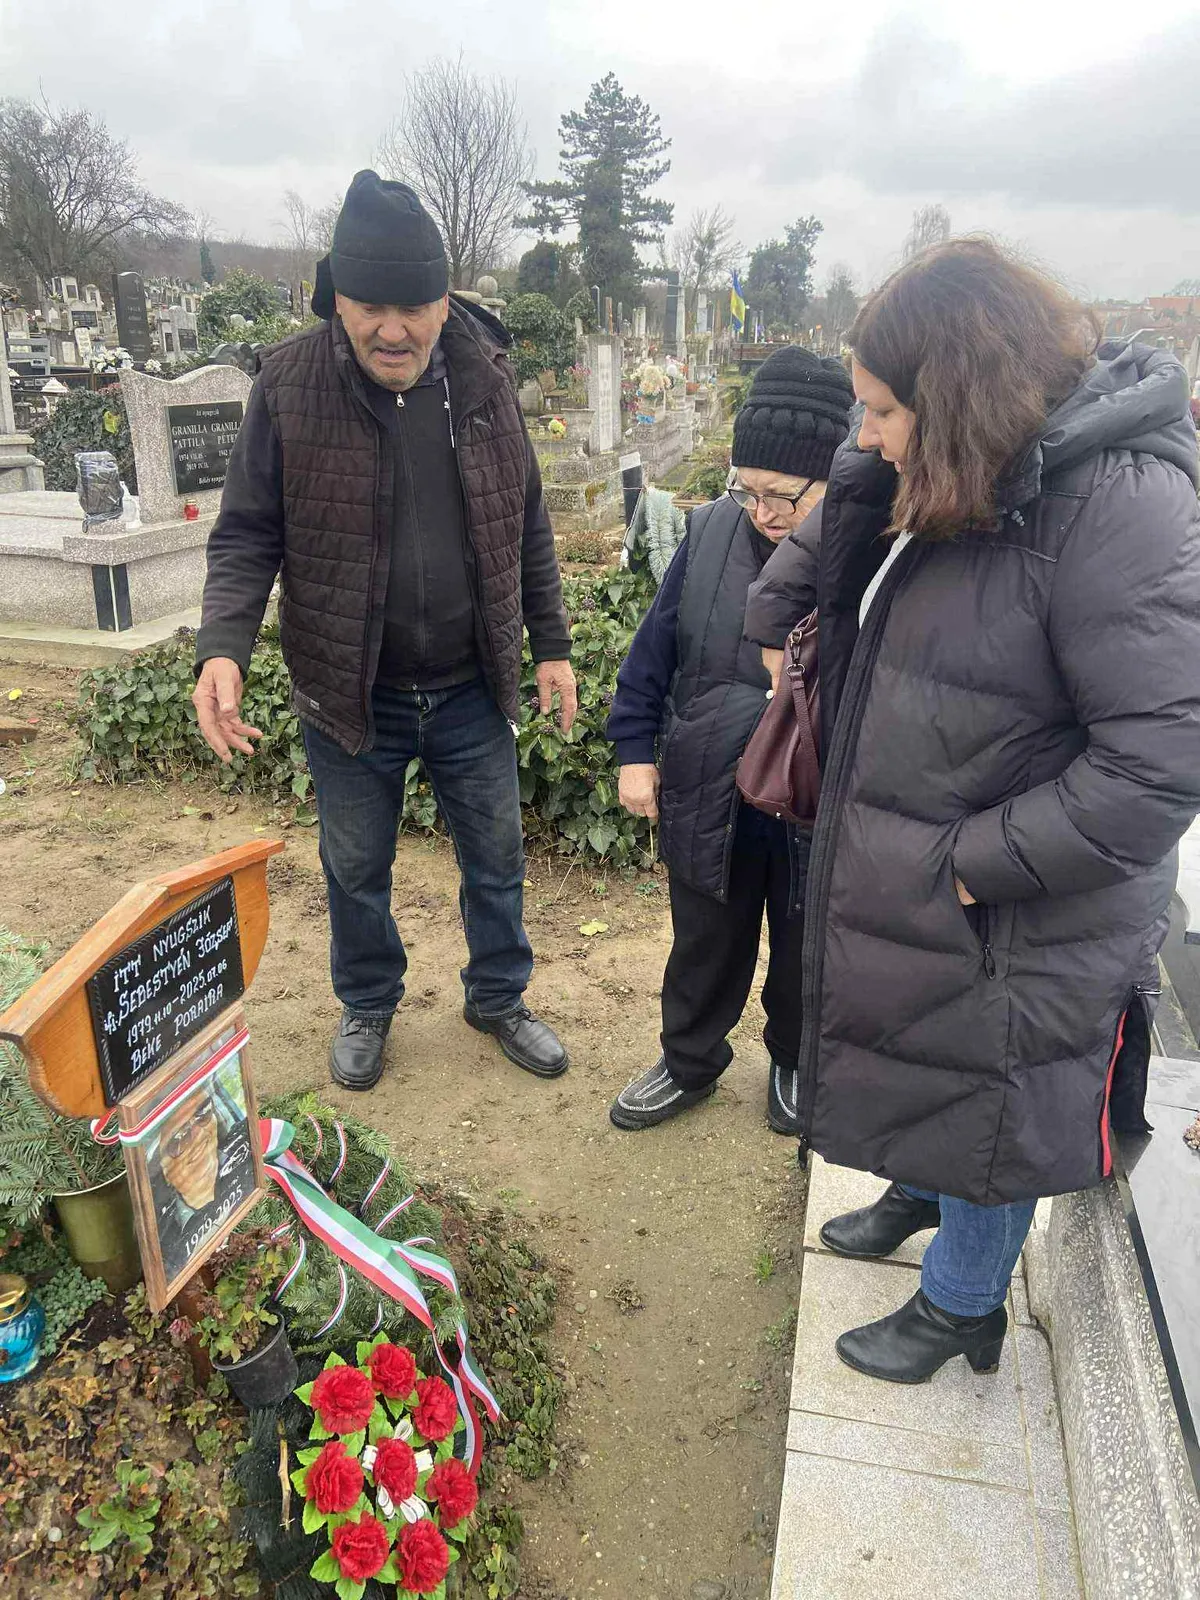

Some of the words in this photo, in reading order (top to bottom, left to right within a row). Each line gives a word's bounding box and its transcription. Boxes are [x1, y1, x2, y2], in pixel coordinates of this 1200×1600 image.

[172, 424, 208, 436] GRANILLA
[177, 437, 206, 449] ATTILA
[211, 421, 242, 433] GRANILL
[114, 954, 142, 993] ITT
[153, 904, 211, 962] NYUGSZIK
[118, 947, 191, 1027] SEBESTYÉN
[173, 983, 224, 1037] PORAIRA
